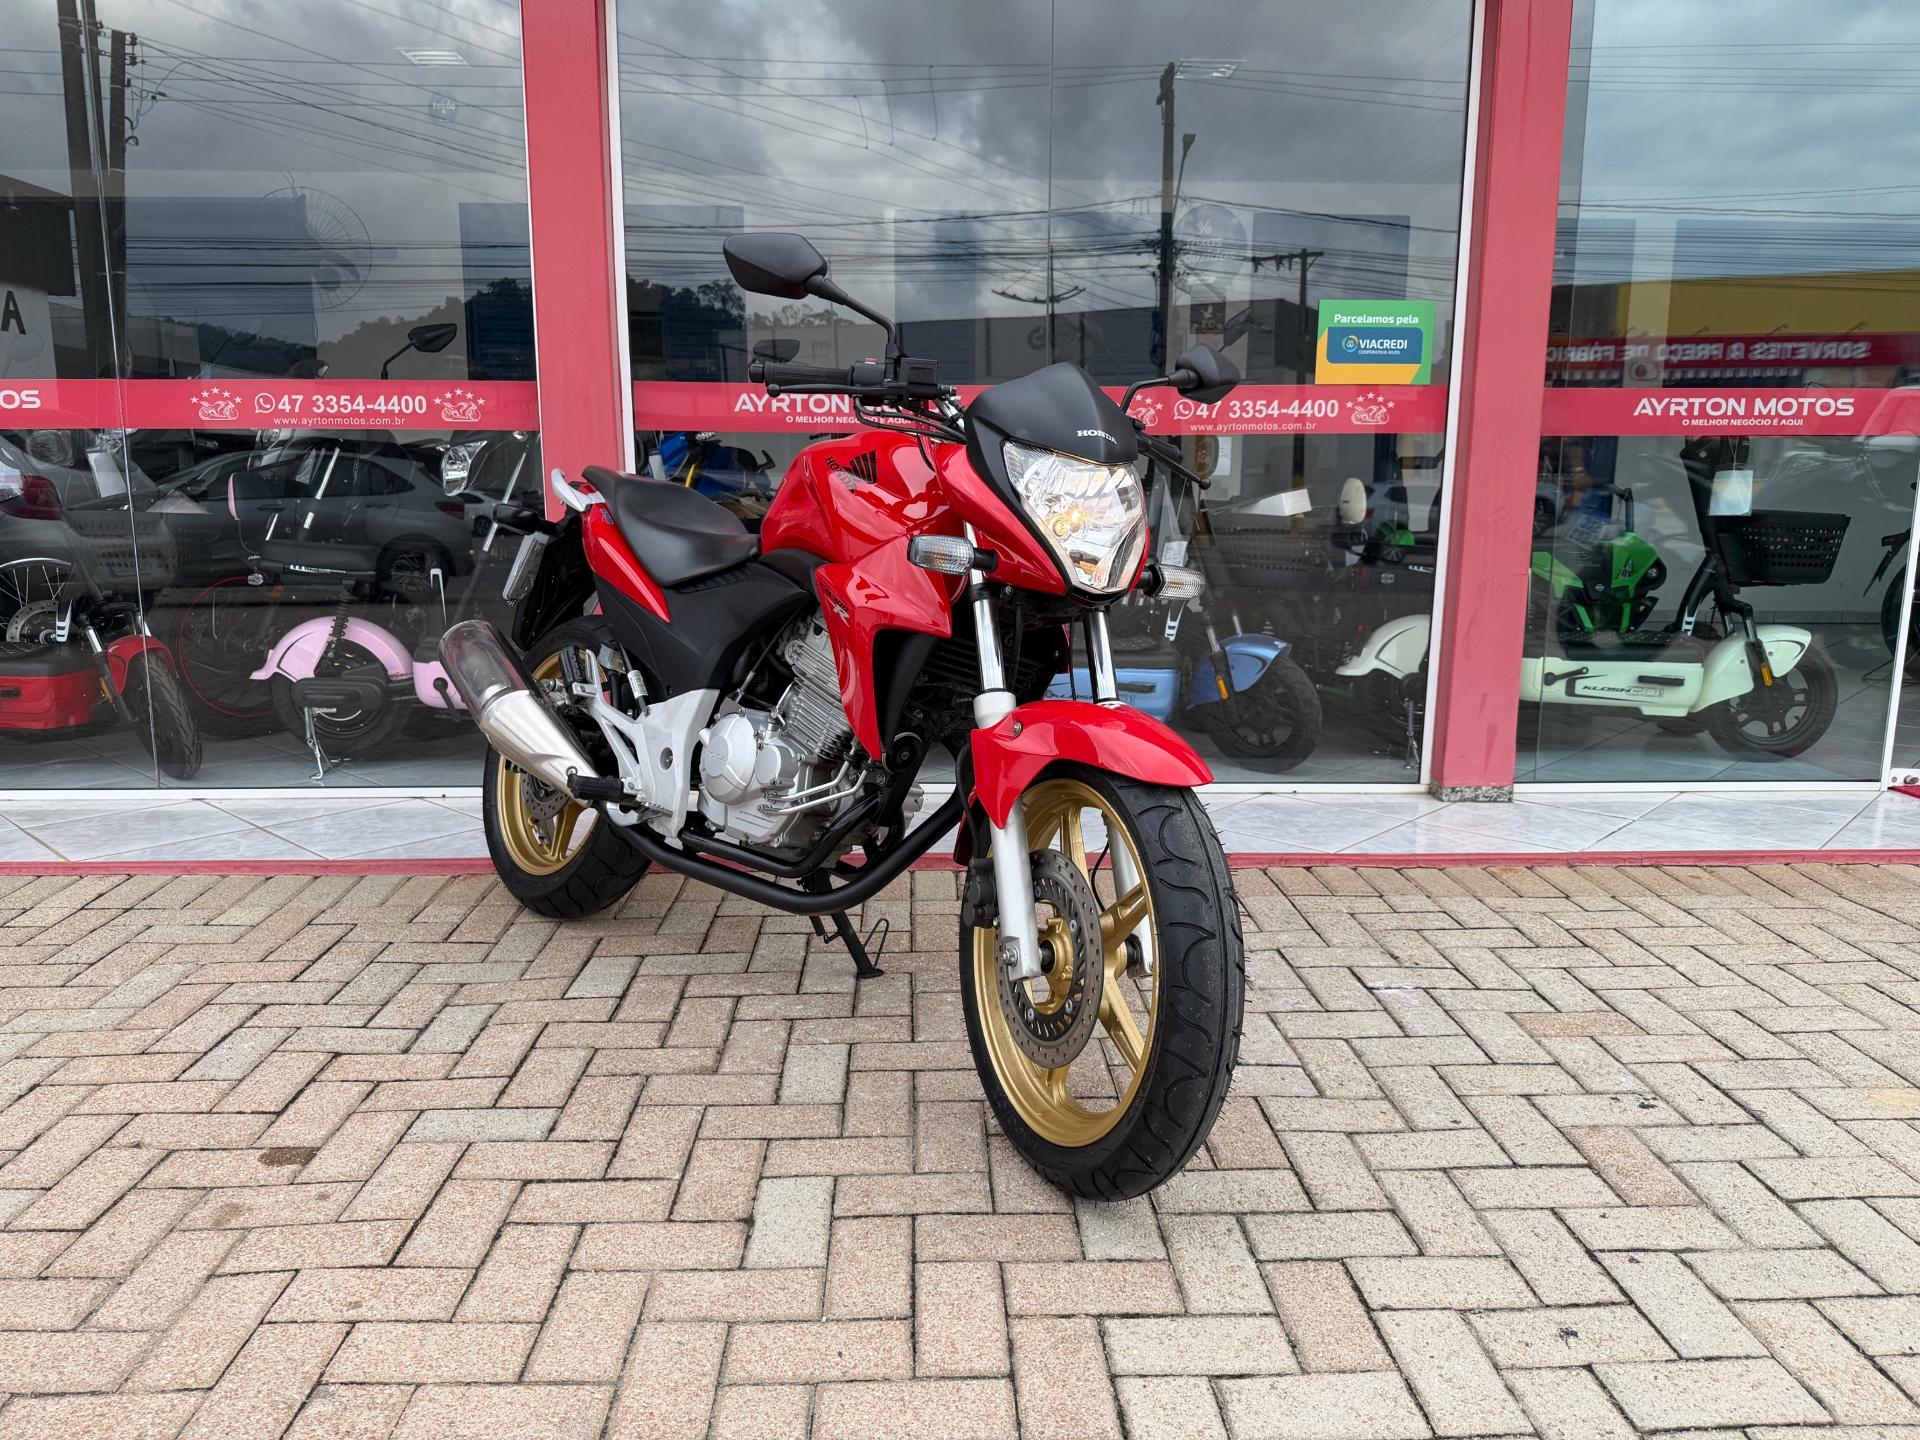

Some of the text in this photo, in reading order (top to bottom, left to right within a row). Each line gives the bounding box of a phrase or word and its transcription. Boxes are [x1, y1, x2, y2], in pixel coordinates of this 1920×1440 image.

[1333, 313, 1419, 326] Parcelamos pela
[1359, 338, 1408, 350] VIACREDI
[277, 395, 427, 414] 47 3354-4400
[734, 392, 850, 413] AYRTON
[1196, 399, 1339, 419] 47 3354-4400
[1633, 397, 1855, 416] AYRTON MOTOS
[273, 416, 405, 427] www.ayrtonmotos.com.br
[795, 415, 834, 424] MELHOR
[1190, 421, 1316, 431] www.ayrtonmotos.com.br
[1691, 418, 1729, 426] MELHOR
[1730, 417, 1770, 426] NEGÓCIO
[1772, 417, 1779, 426] É
[1076, 429, 1118, 445] HONDA
